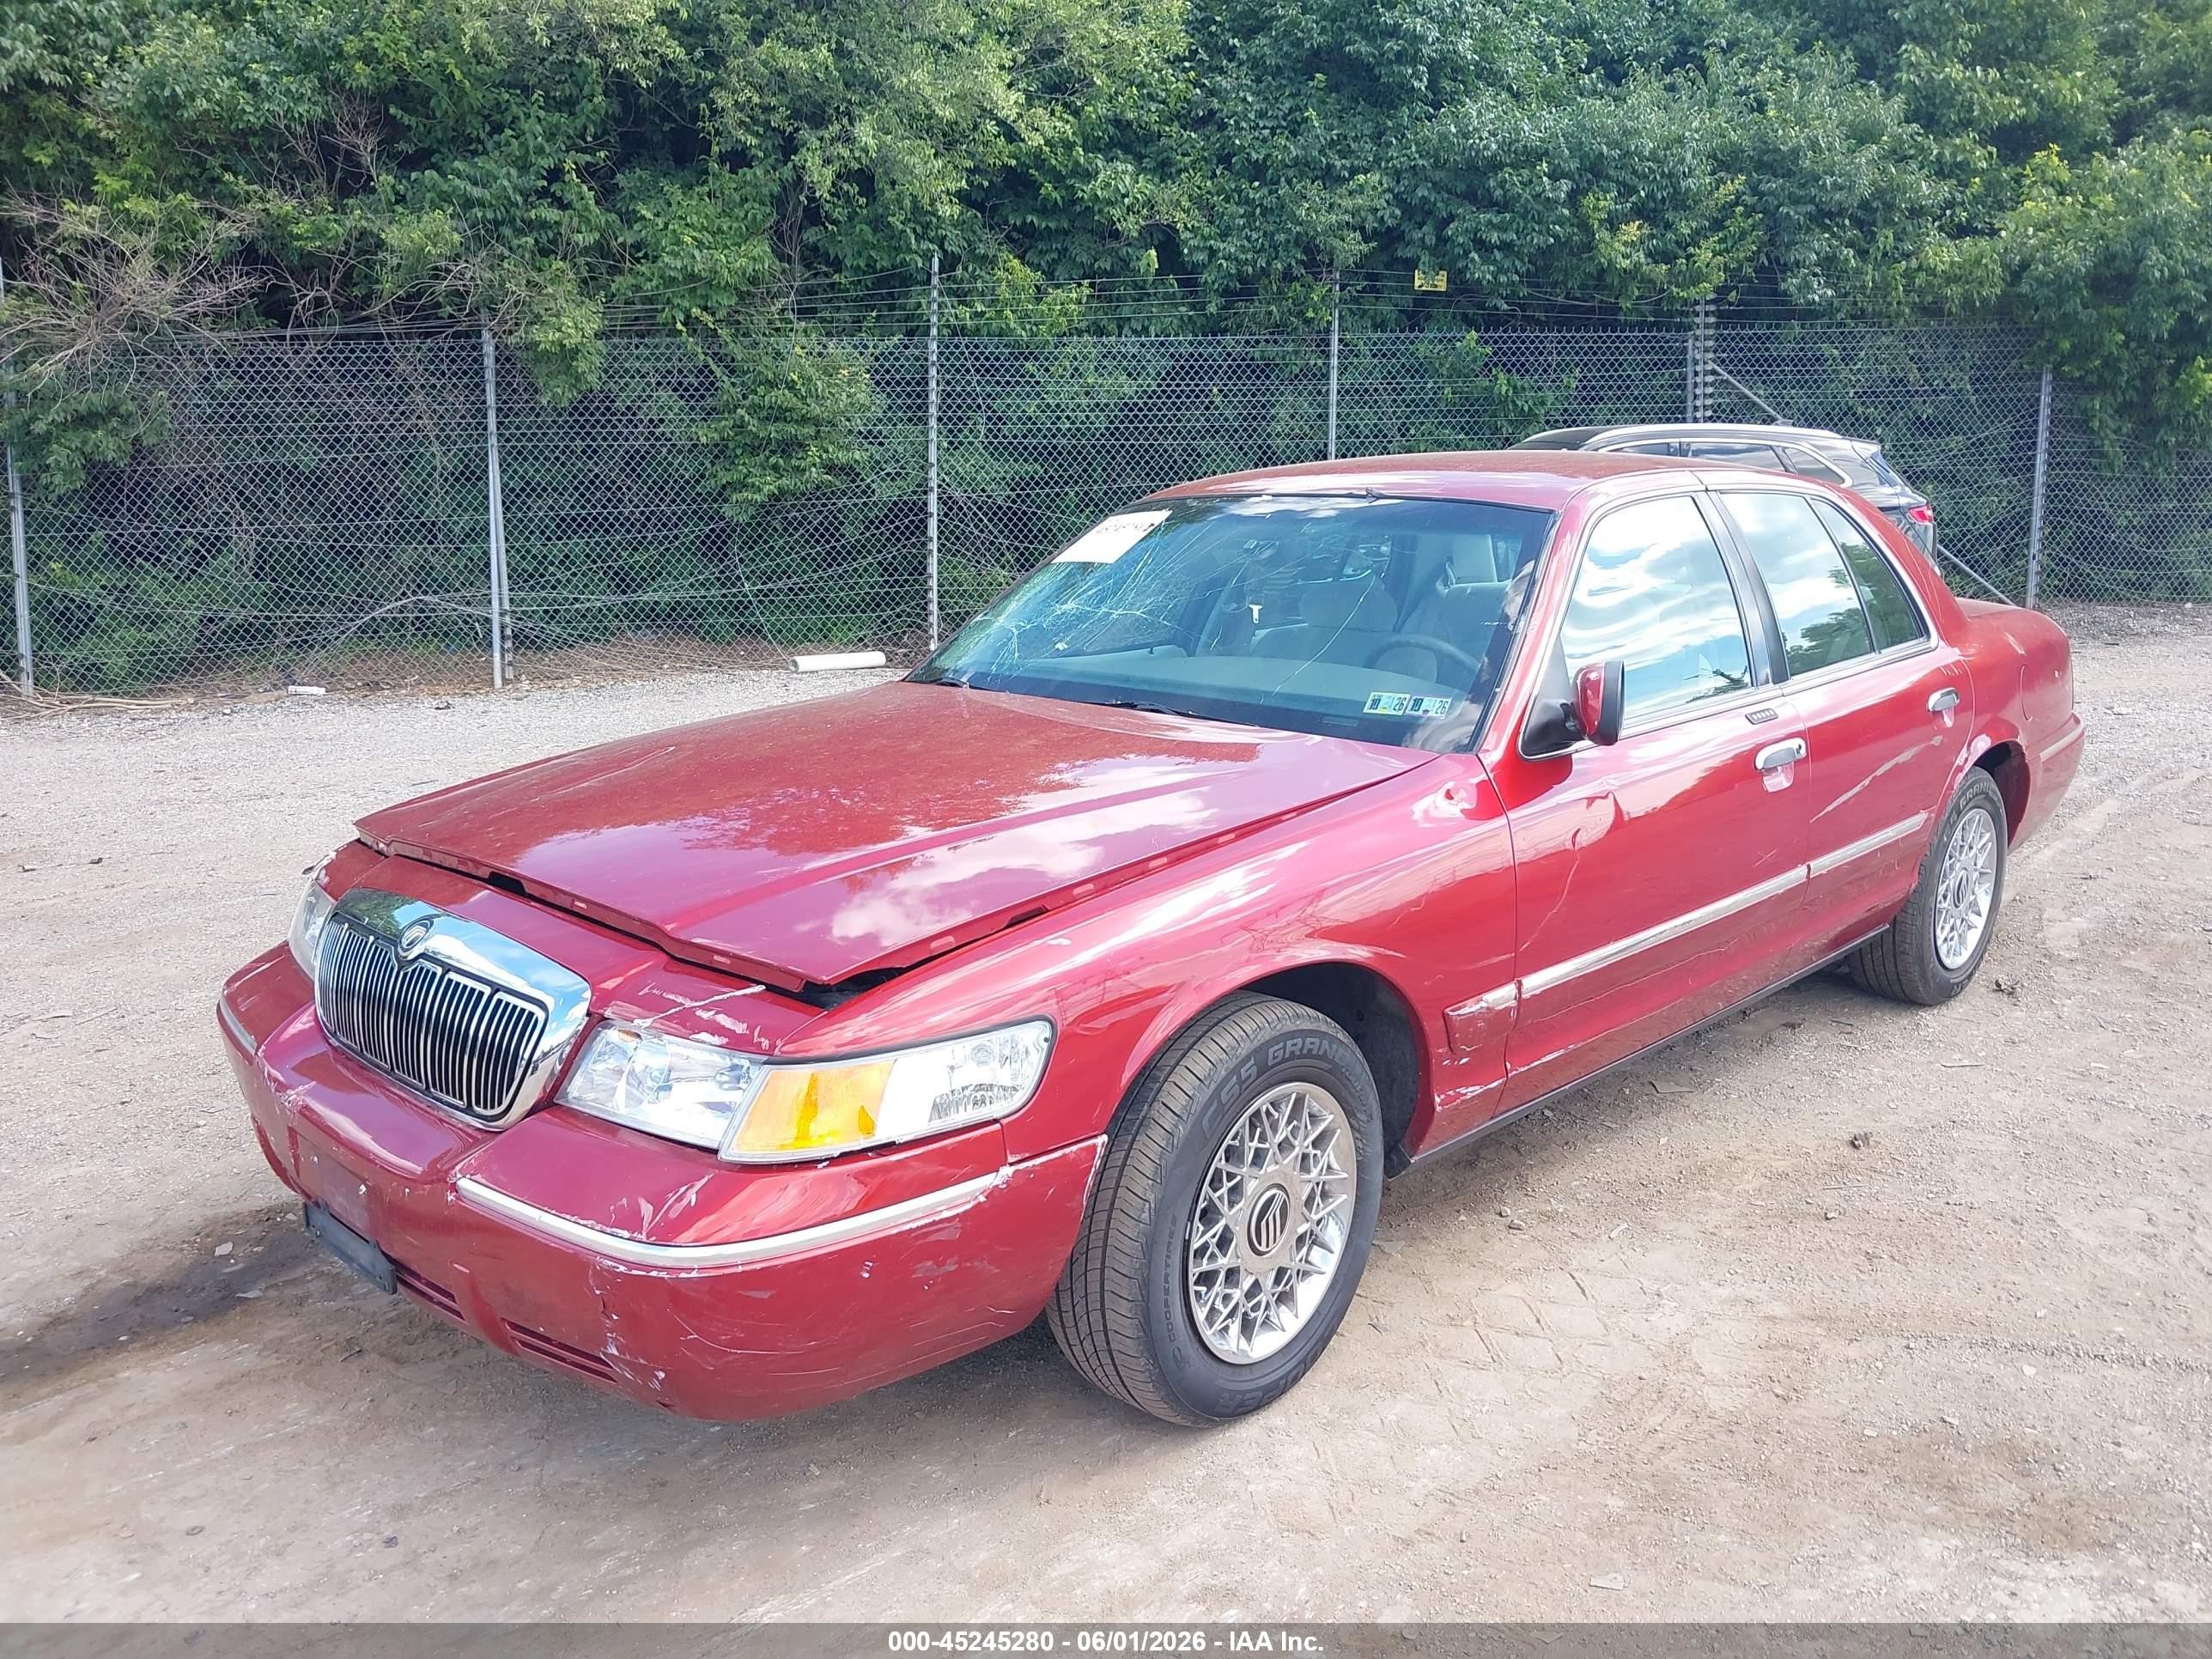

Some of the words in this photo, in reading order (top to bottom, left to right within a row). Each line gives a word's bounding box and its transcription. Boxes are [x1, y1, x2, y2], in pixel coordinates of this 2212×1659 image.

[1369, 697, 1382, 710] 10
[1393, 696, 1407, 711] 26
[1410, 697, 1425, 712] 10
[1435, 700, 1449, 714] 26
[1267, 1037, 1349, 1066] GRAND
